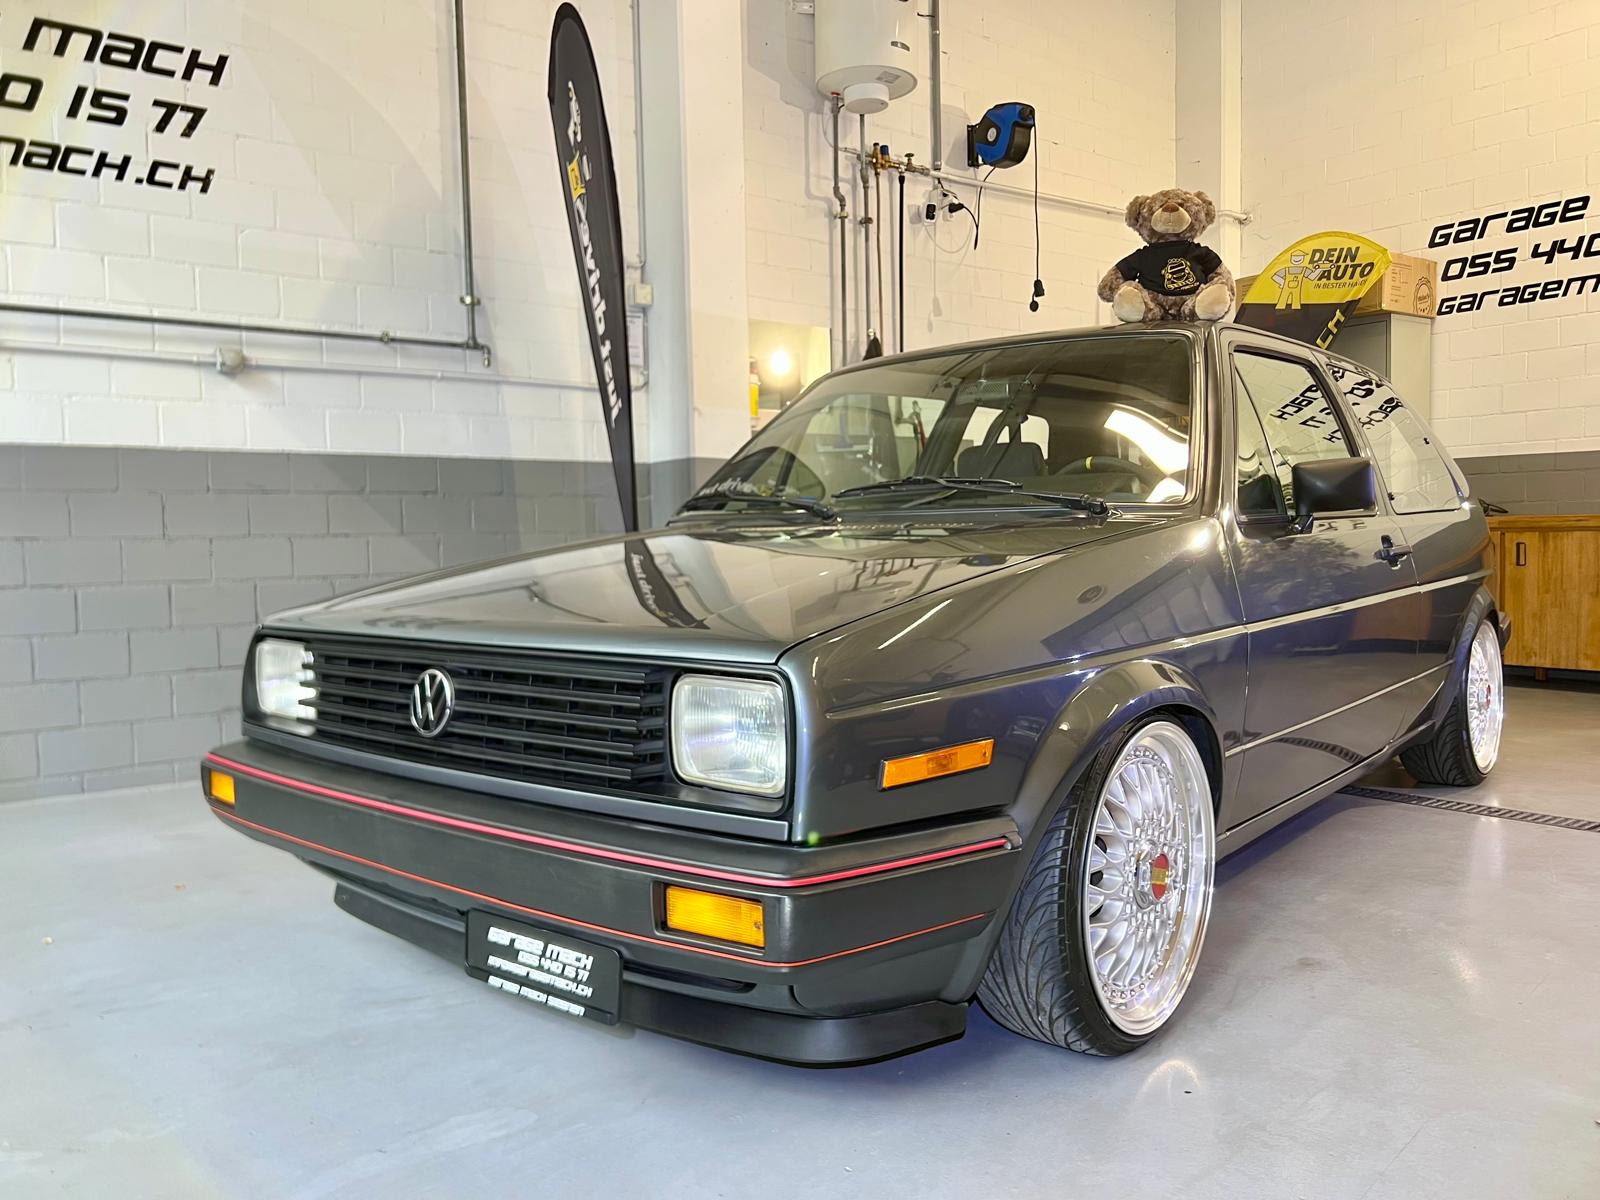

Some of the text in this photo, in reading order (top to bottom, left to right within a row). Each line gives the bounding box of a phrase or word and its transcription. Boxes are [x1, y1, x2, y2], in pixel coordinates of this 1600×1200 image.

[152, 98, 208, 138] 77
[1308, 246, 1361, 265] DEIN
[1441, 247, 1519, 282] 055
[1317, 262, 1375, 282] AUTO
[1322, 281, 1348, 290] BESTER
